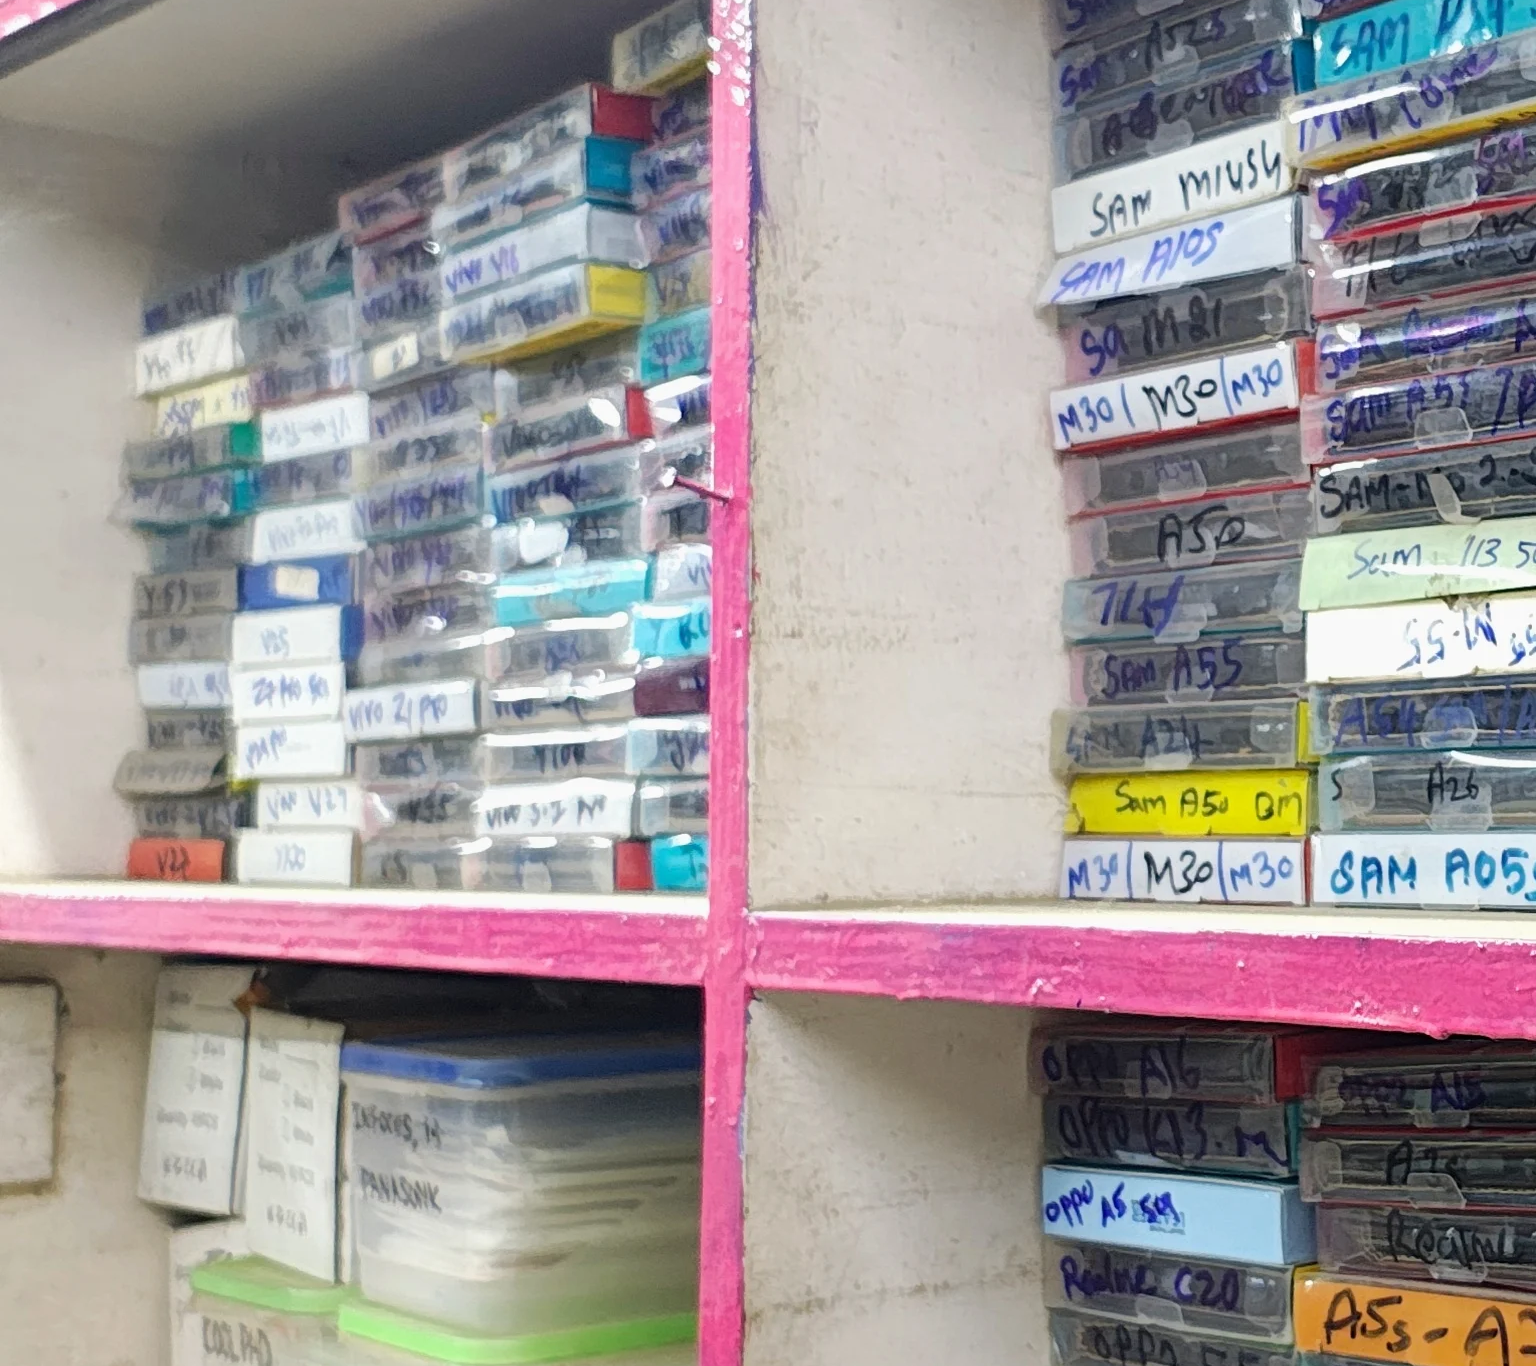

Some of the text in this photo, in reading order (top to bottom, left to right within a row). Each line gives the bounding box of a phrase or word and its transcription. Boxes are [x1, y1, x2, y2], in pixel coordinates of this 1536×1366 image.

[1090, 191, 1152, 237] SAM
[1116, 780, 1166, 814] Sam
[1330, 849, 1417, 899] SAM
